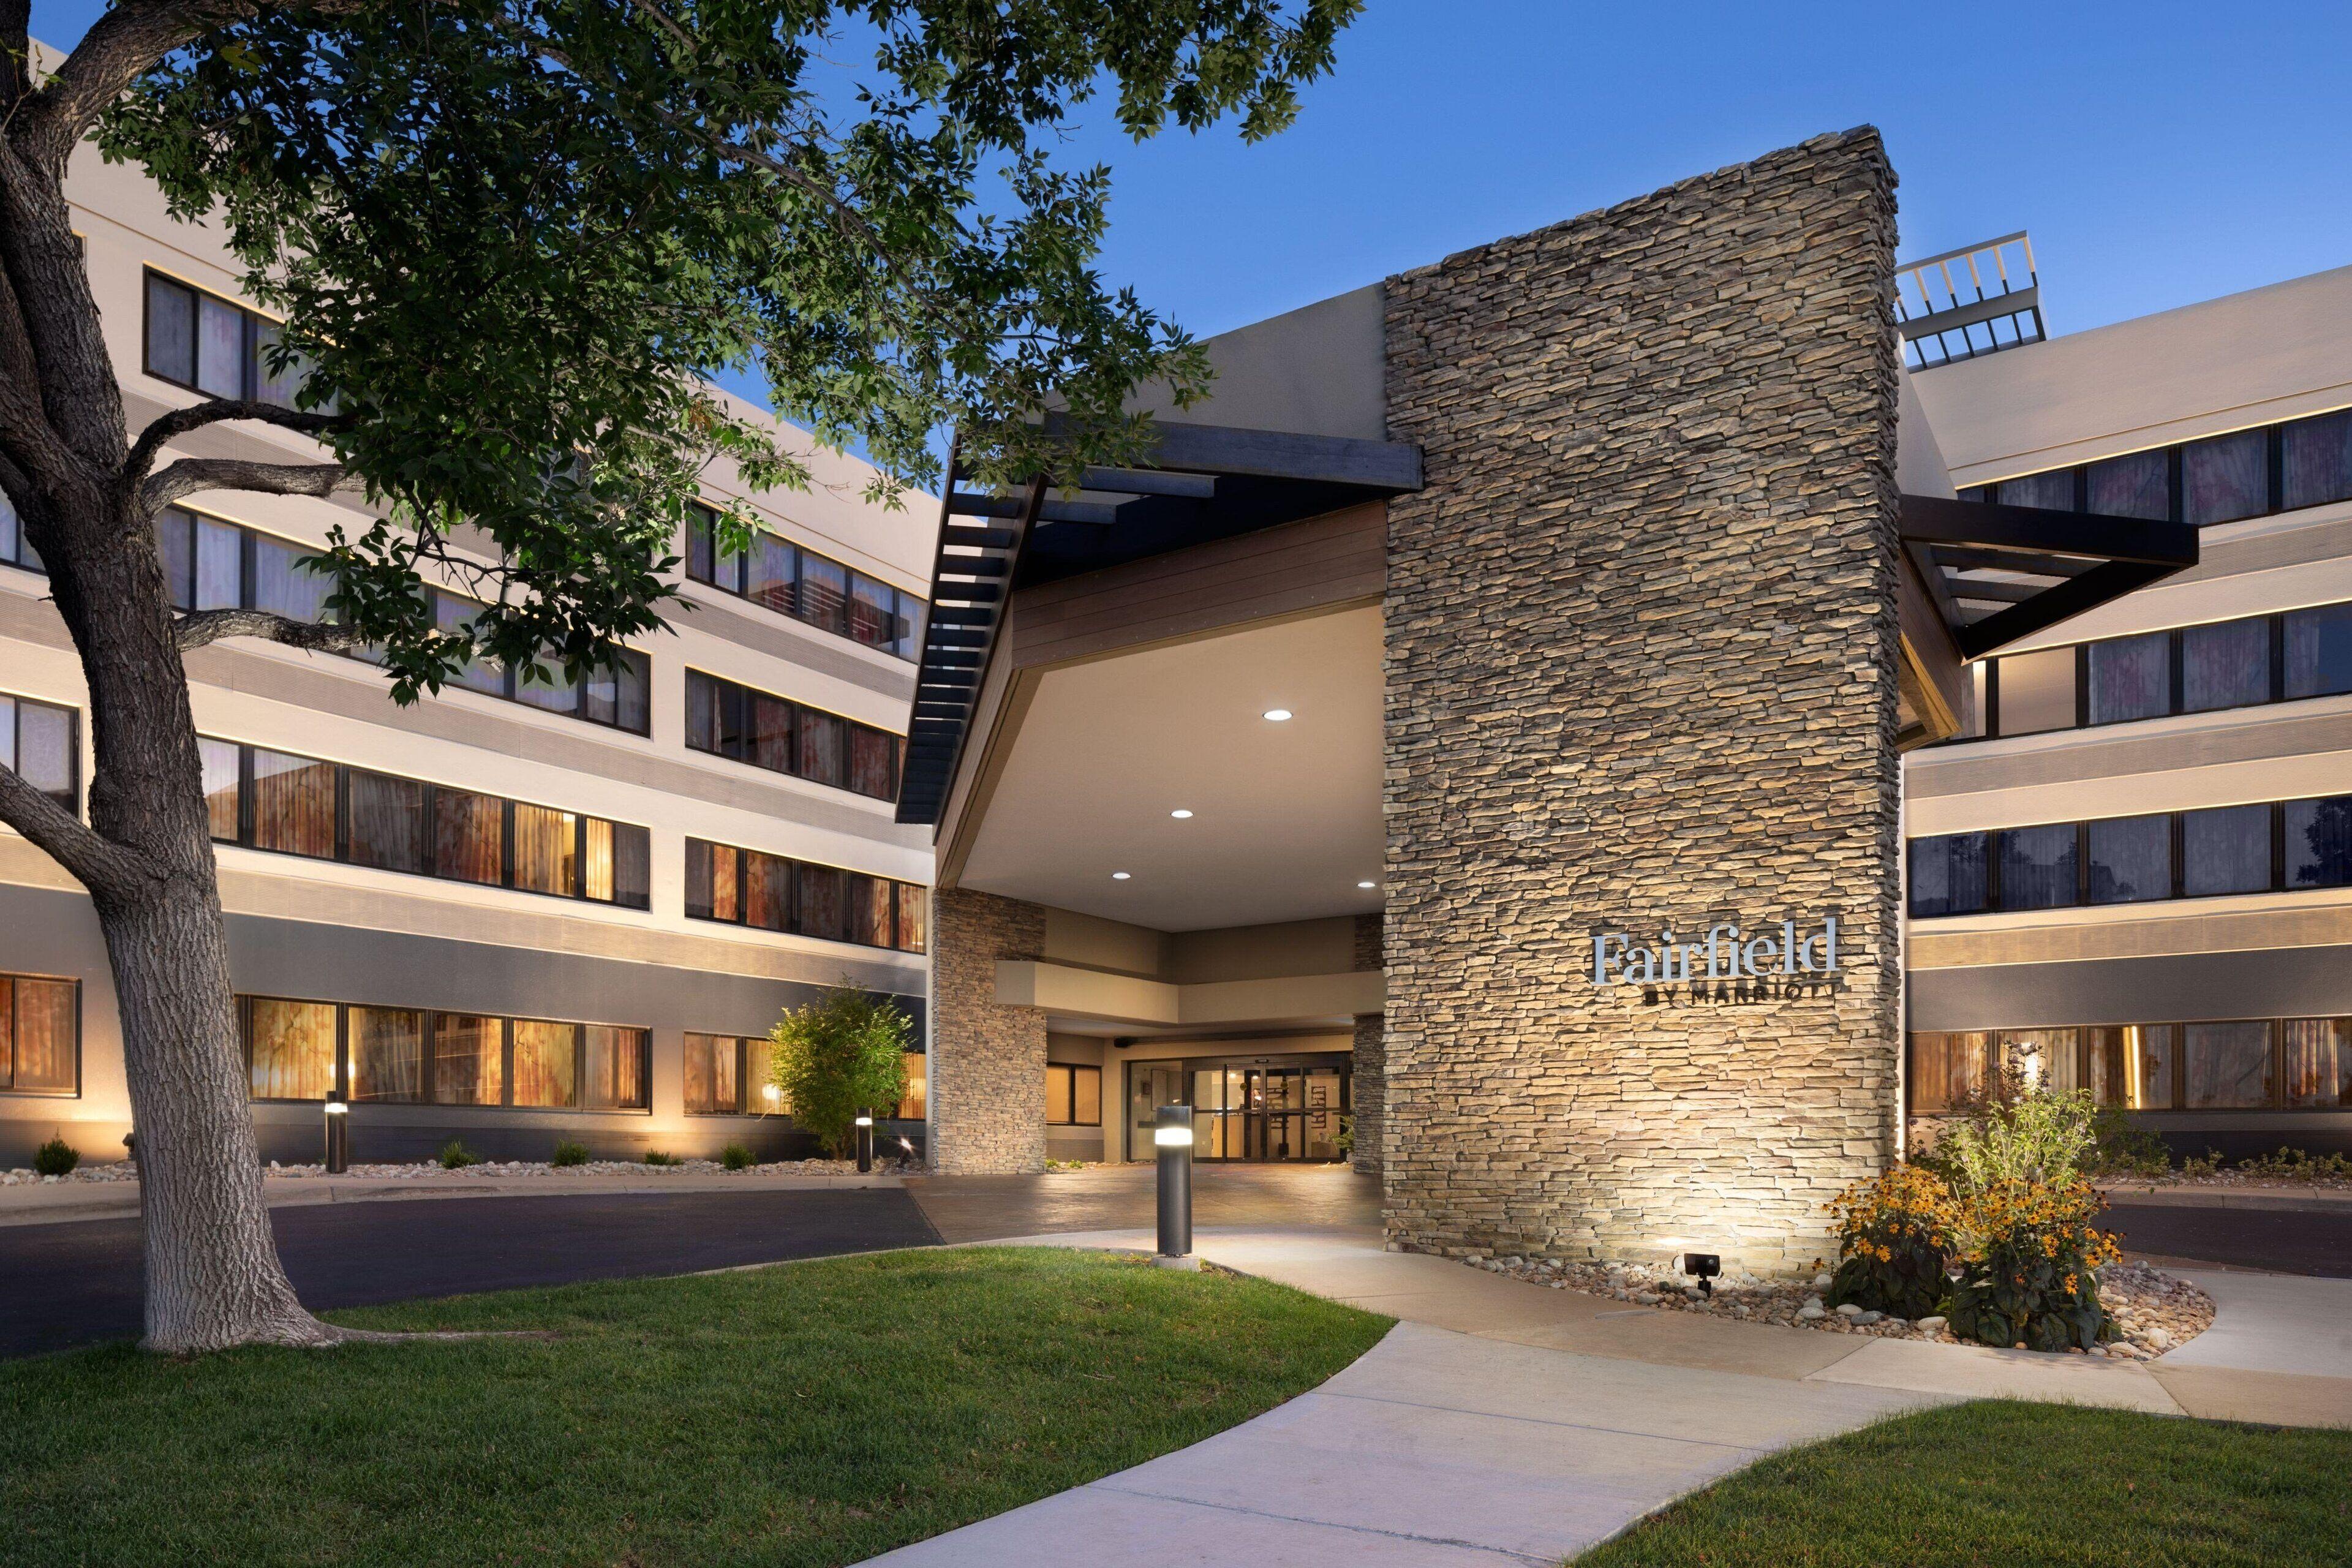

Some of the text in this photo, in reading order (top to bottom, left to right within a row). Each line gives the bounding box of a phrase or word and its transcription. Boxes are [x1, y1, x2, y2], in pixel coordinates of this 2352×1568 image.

[1591, 918, 1840, 986] Fairfield
[1645, 981, 1840, 1006] BY MARRIOTT
